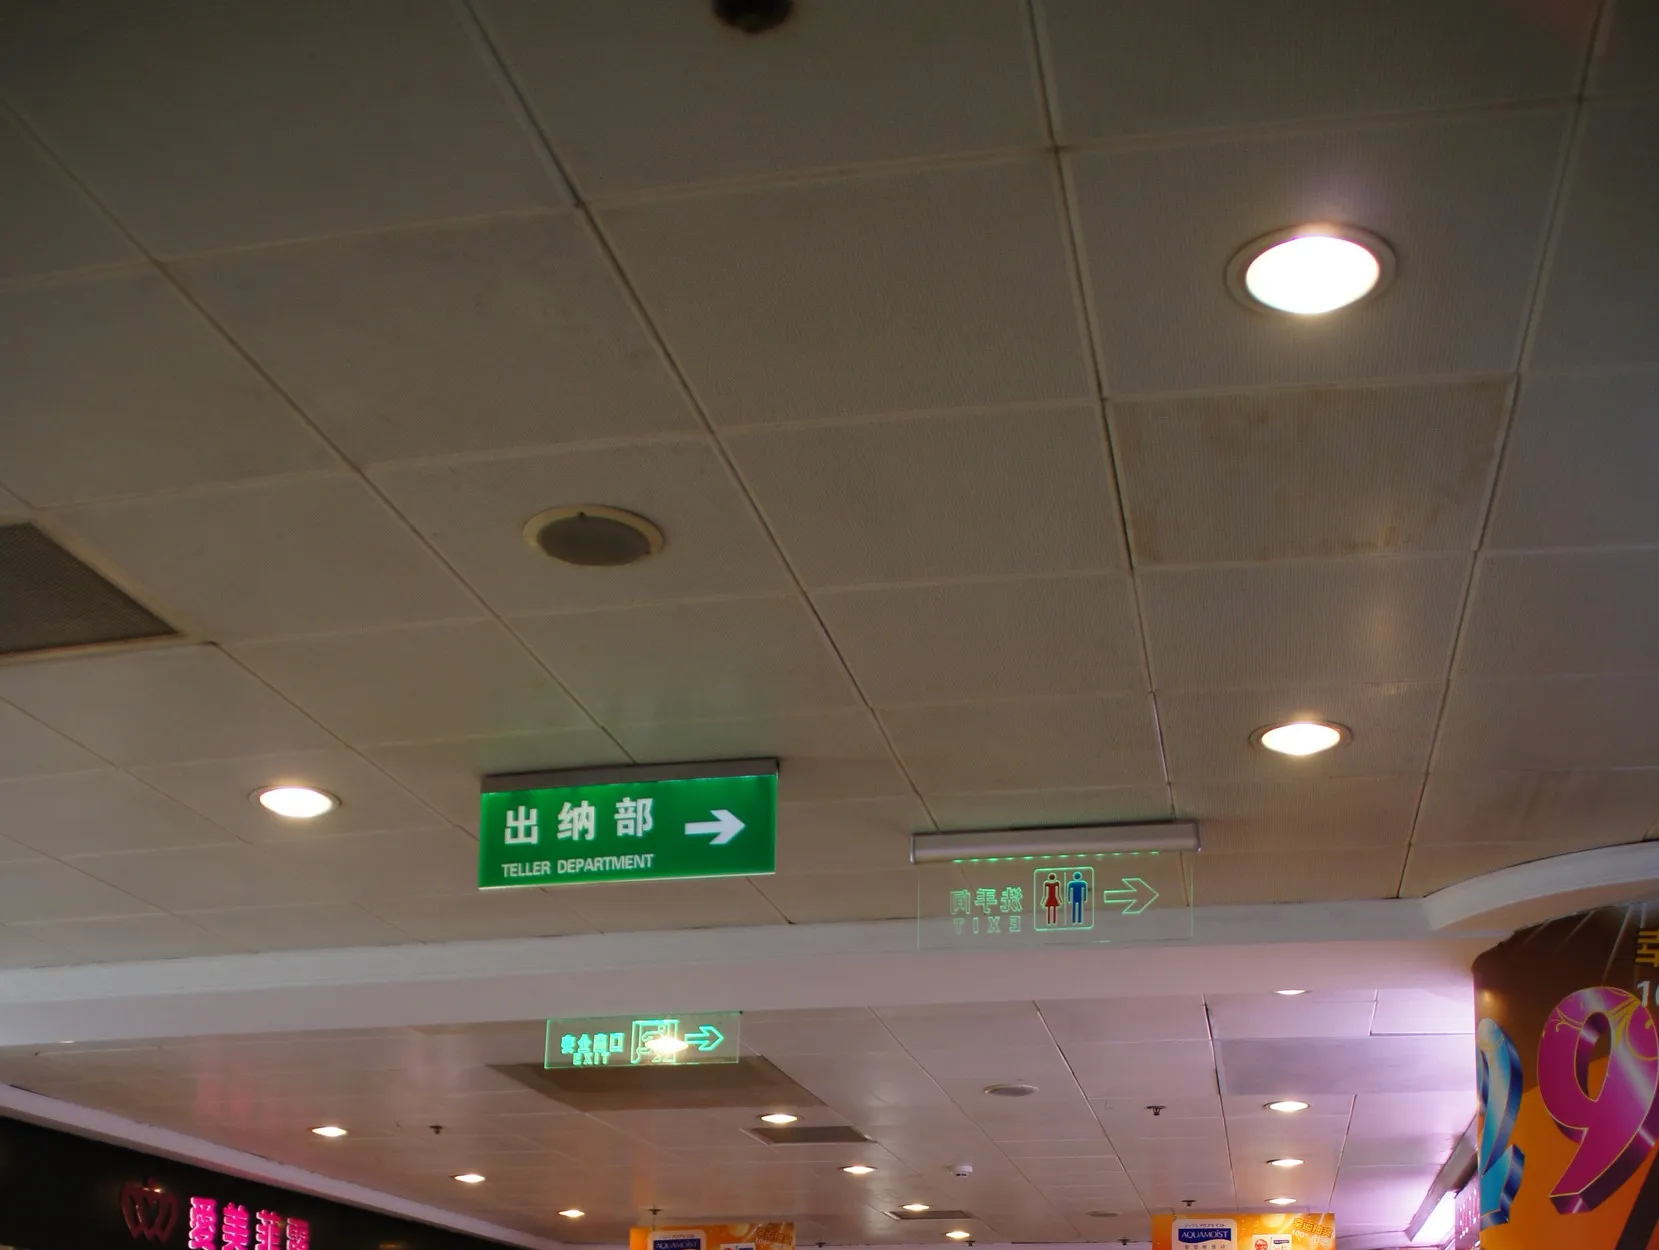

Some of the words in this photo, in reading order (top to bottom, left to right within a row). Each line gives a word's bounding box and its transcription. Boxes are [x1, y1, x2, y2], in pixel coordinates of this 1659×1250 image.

[504, 797, 654, 845] 出纳部
[501, 860, 552, 877] TELLER
[557, 853, 654, 875] DEPARTMENT
[572, 1052, 611, 1066] EXIT
